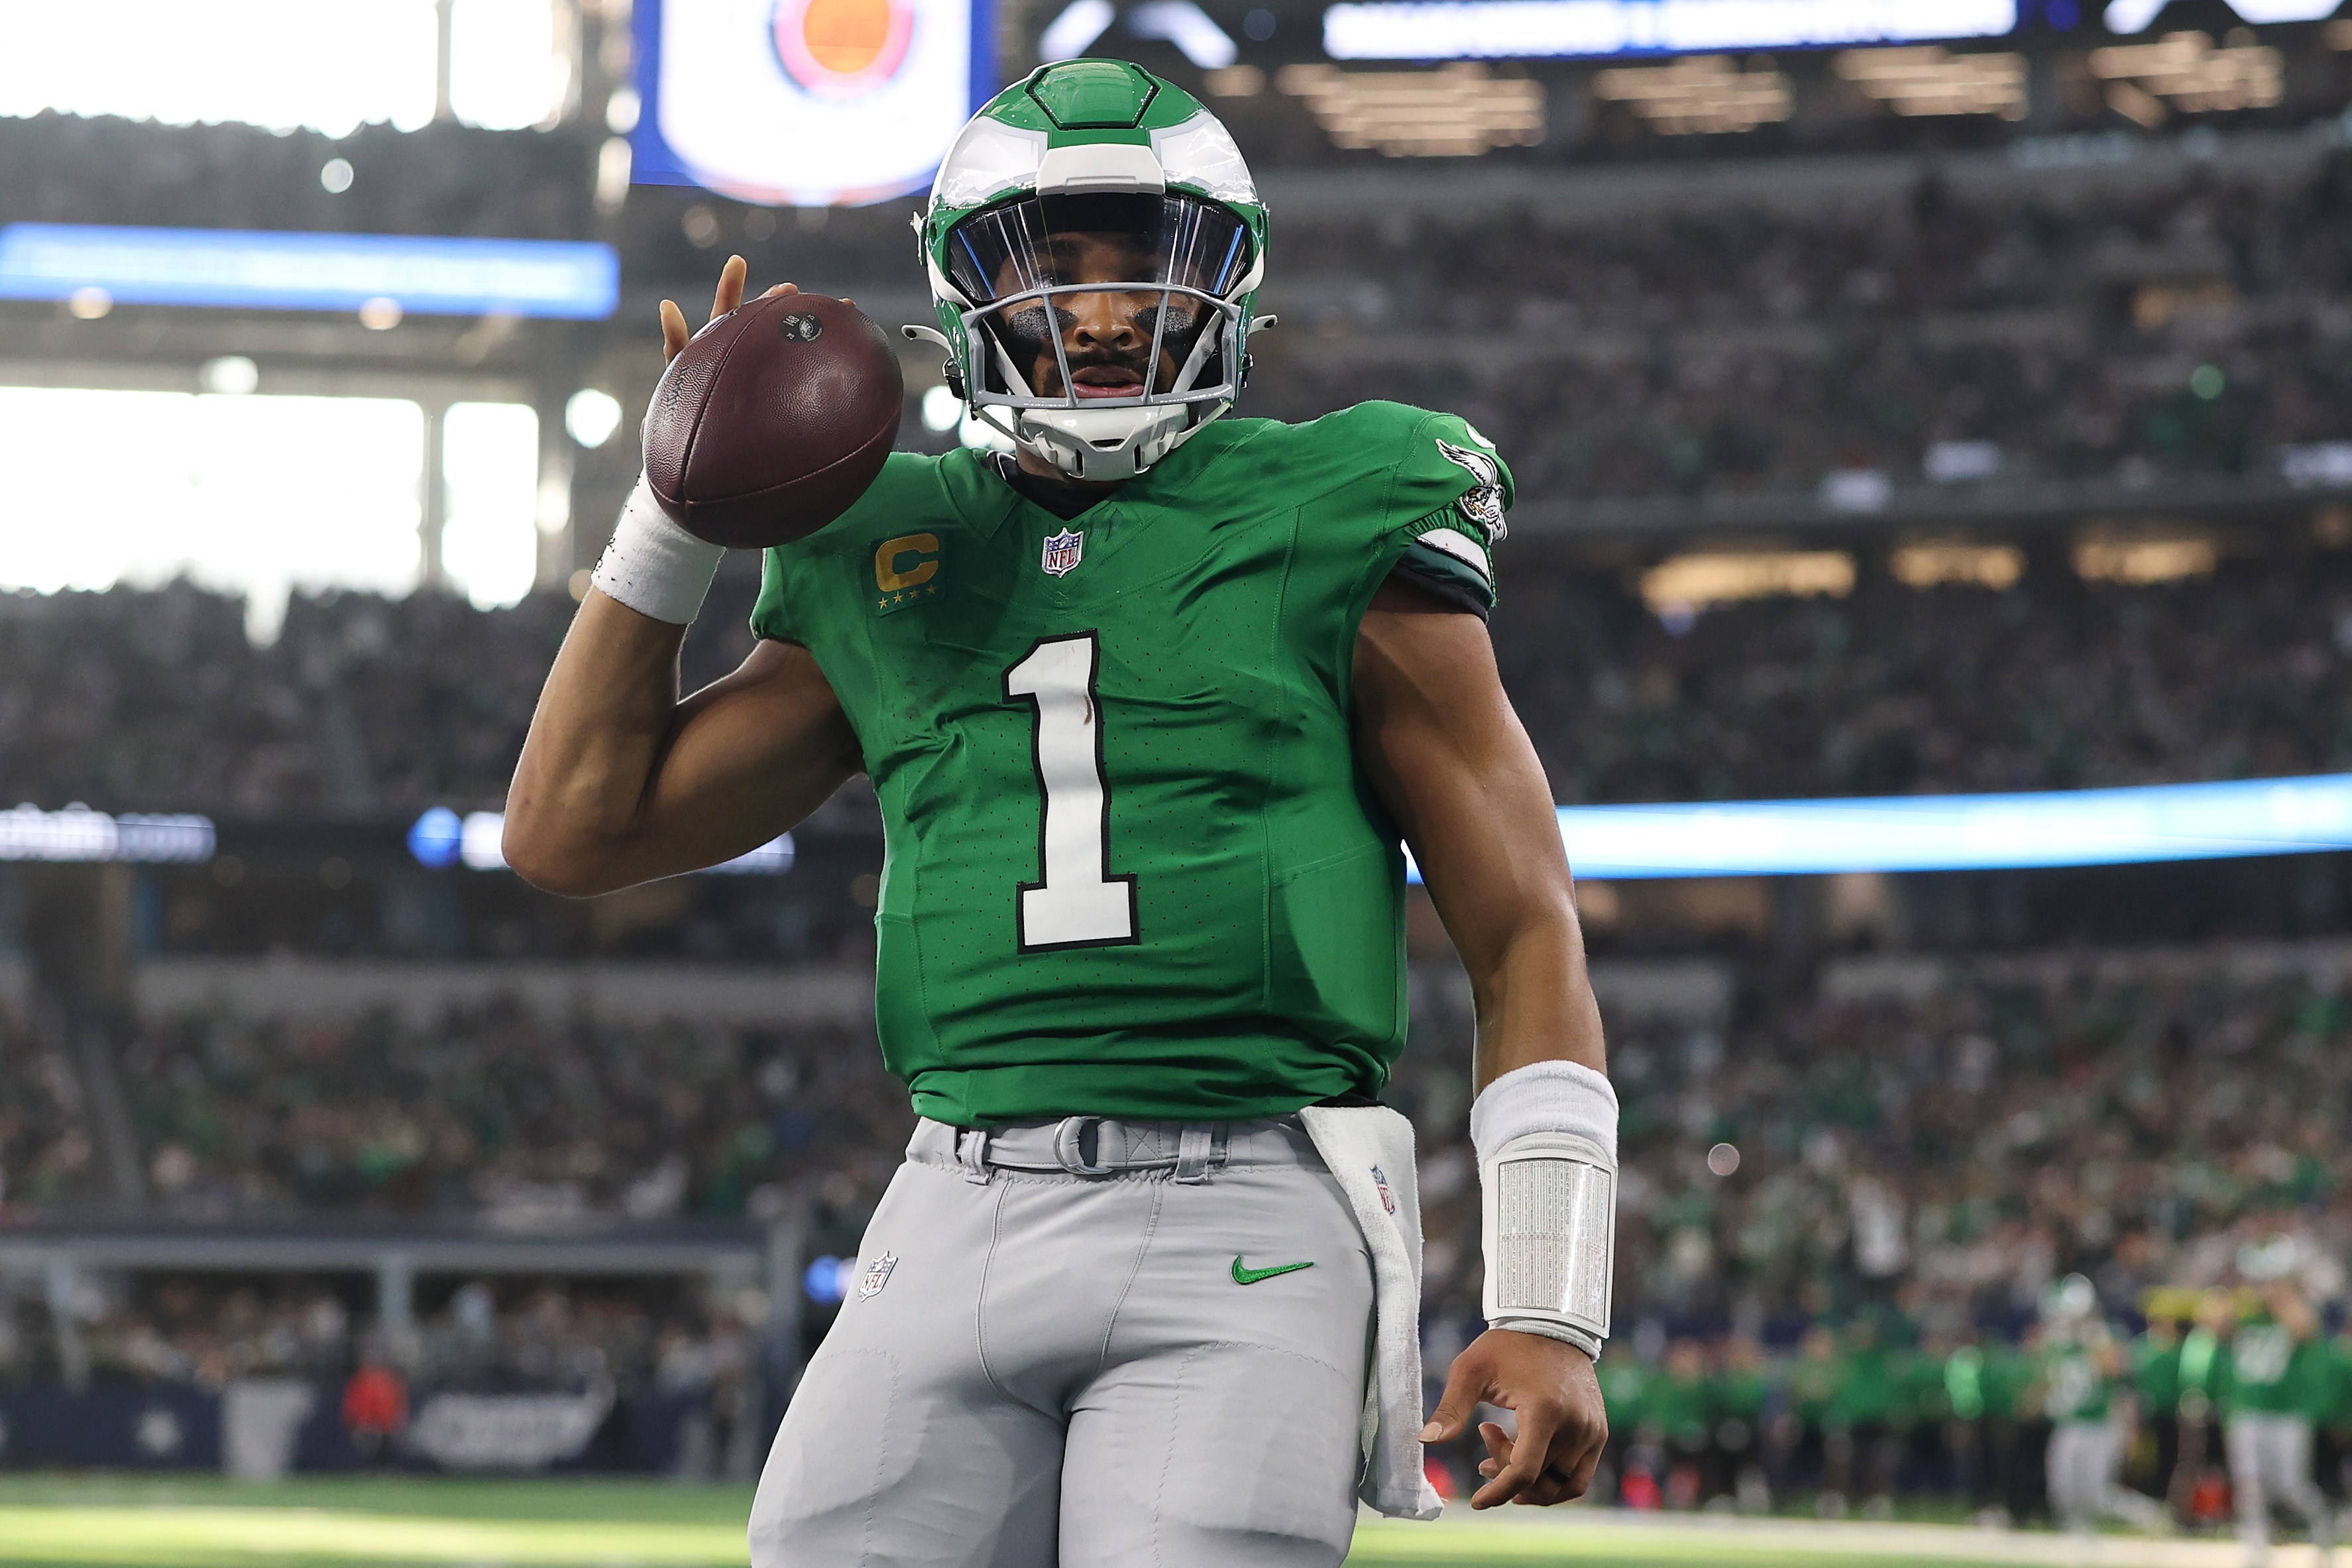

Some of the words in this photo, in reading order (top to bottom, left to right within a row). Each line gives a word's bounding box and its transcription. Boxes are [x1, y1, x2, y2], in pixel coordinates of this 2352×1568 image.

[875, 533, 940, 592] C
[1048, 548, 1075, 569] NFL
[1001, 628, 1141, 954] 1
[862, 1274, 882, 1292] NFL
